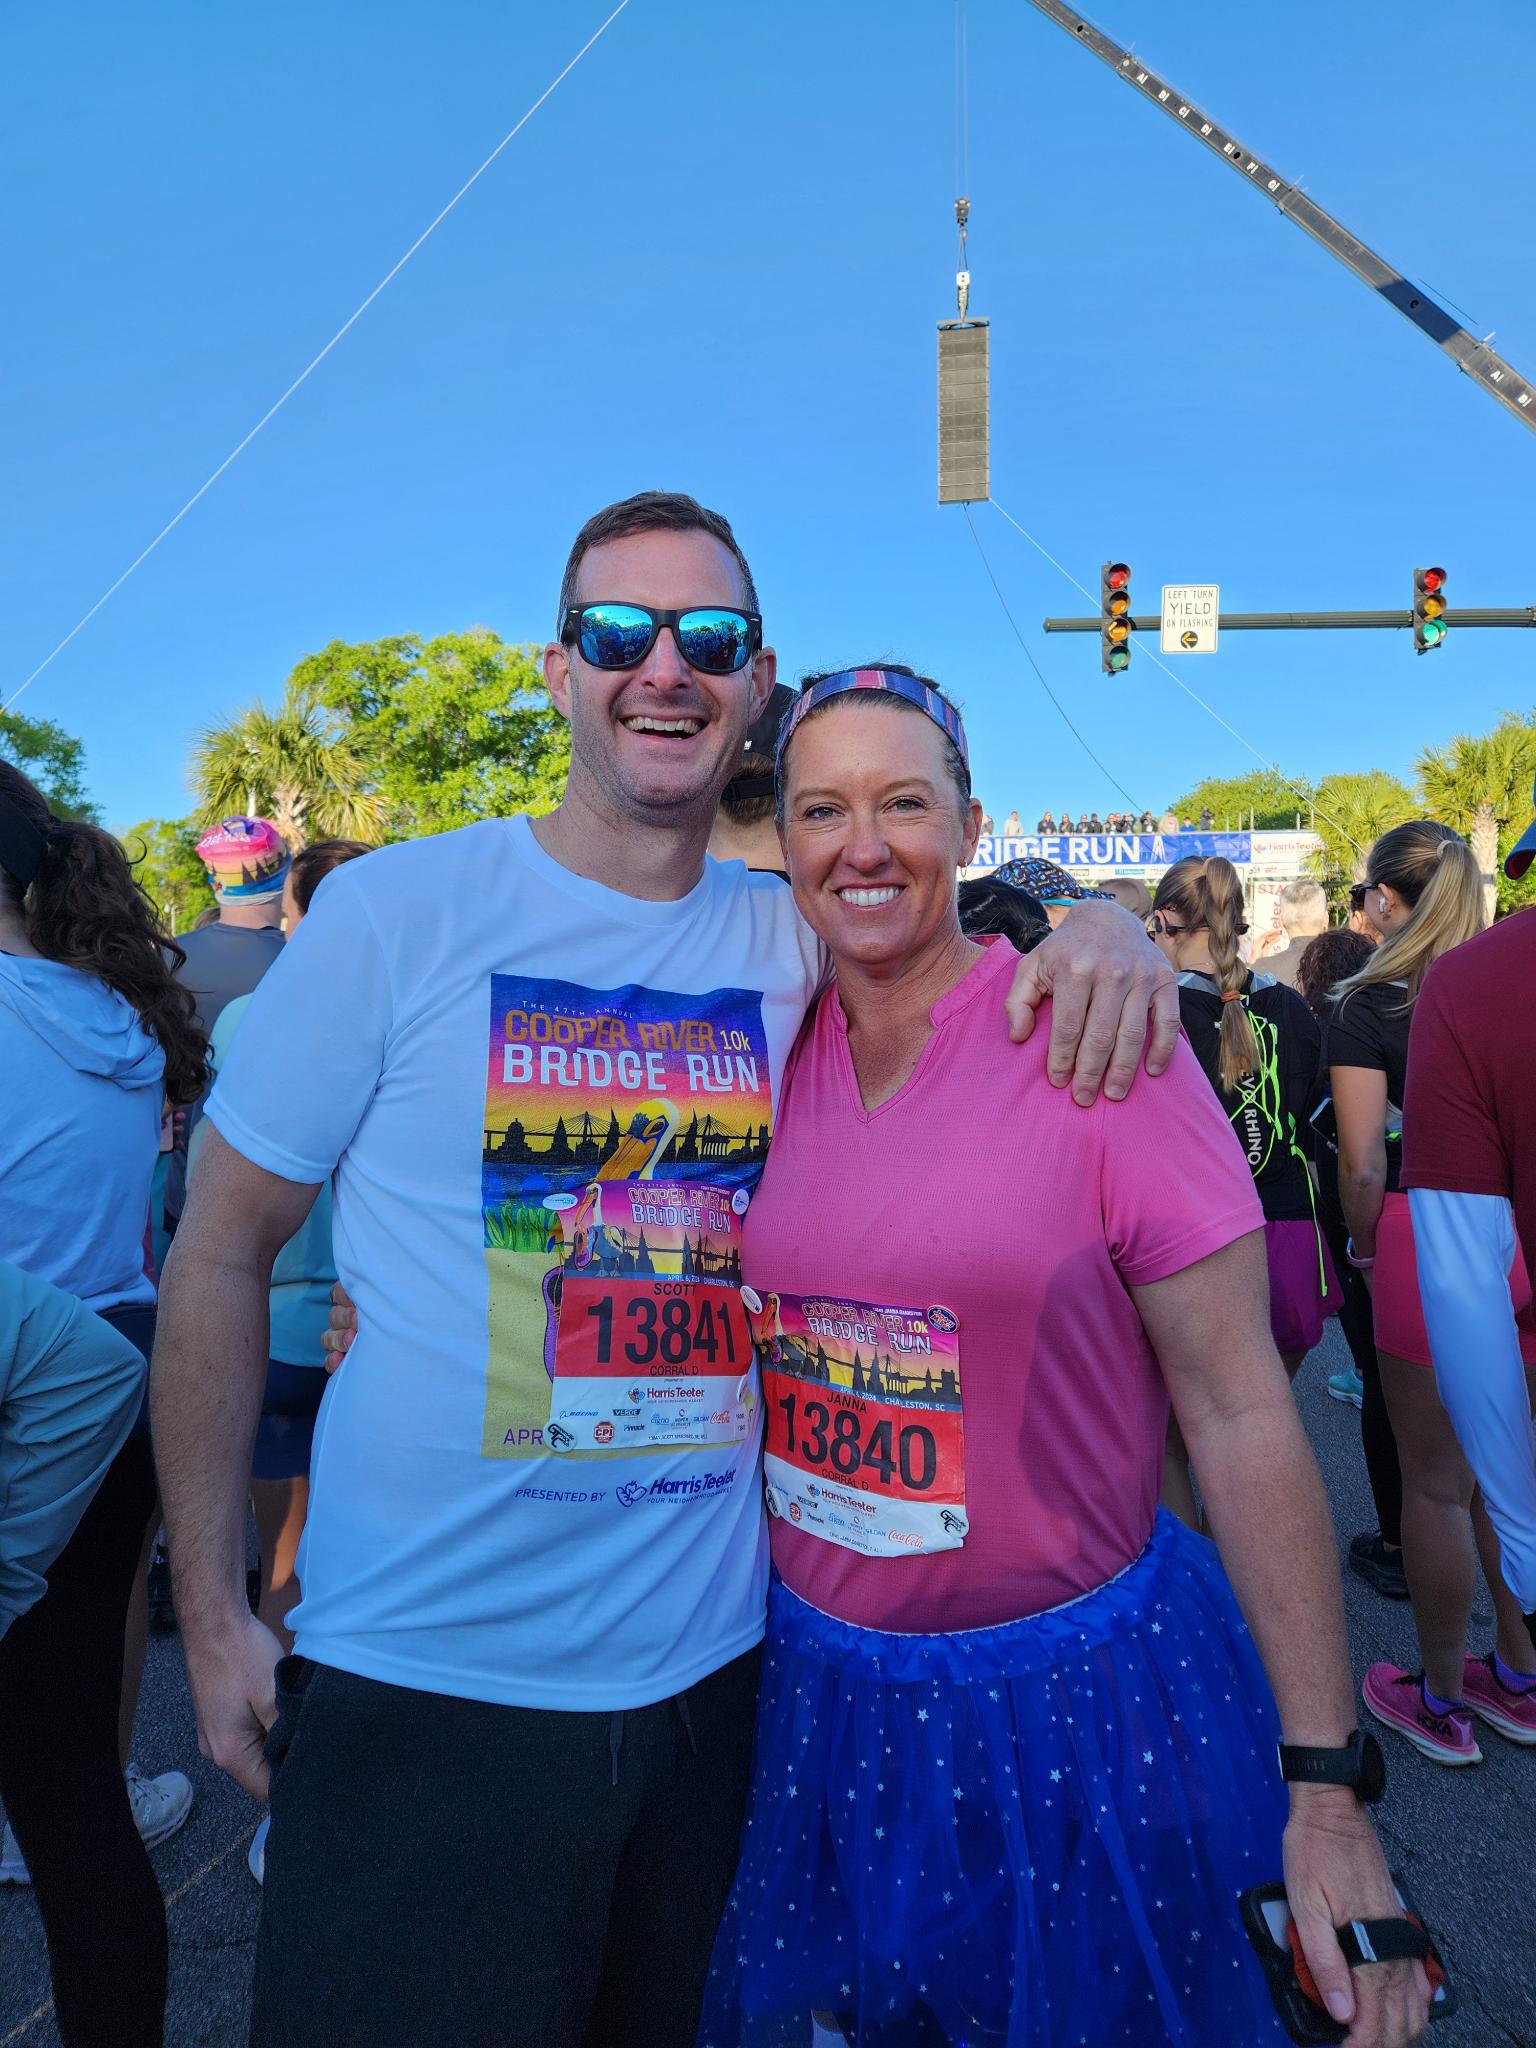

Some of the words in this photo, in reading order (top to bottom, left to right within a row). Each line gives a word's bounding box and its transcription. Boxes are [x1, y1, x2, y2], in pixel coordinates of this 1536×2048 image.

[1168, 591, 1187, 599] LEFT
[1193, 591, 1213, 599] TURN
[1170, 602, 1211, 615] YIELD
[1166, 619, 1176, 628] ON
[1180, 618, 1213, 628] FLASHING
[974, 836, 1061, 864] RIDGE
[1068, 836, 1139, 863] RUN
[522, 1001, 545, 1011] THE
[555, 1007, 585, 1016] 47TH
[595, 1008, 633, 1018] ANNUAL
[505, 1010, 631, 1048] COOPER
[637, 1022, 718, 1052] RIVER
[720, 1030, 751, 1052] 10k
[503, 1044, 667, 1090] BRIDGE
[686, 1055, 760, 1093] RUN
[1244, 1108, 1263, 1165] RHINO
[628, 1187, 685, 1206] COOPER
[689, 1189, 719, 1211] RIVER
[632, 1204, 702, 1228] BRIDGE
[708, 1211, 730, 1233] RUN
[654, 1283, 696, 1297] SCOTT
[802, 1303, 859, 1322] COOPER
[861, 1308, 904, 1333] RIVER
[907, 1320, 928, 1334] 10k
[588, 1296, 736, 1364] 13841
[807, 1317, 879, 1346] BRIDGE
[887, 1331, 932, 1354] RUN
[650, 1365, 690, 1376] CORRAL
[692, 1366, 699, 1376] D
[647, 1388, 675, 1398] Harris
[676, 1388, 705, 1398] Teeter
[828, 1391, 867, 1413] JANNA
[862, 1393, 877, 1401] 2024
[936, 1404, 945, 1412] SC
[504, 1429, 543, 1446] APR
[595, 1429, 614, 1437] CPI
[779, 1392, 937, 1491] 13840
[650, 1476, 702, 1495] Harris
[822, 1468, 859, 1489] CORRAL
[861, 1480, 869, 1491] D
[515, 1489, 588, 1503] PRESENTED
[590, 1491, 606, 1503] BY
[821, 1488, 847, 1504] Harris
[847, 1496, 877, 1513] Teeter
[1417, 1713, 1452, 1737] HOKA
